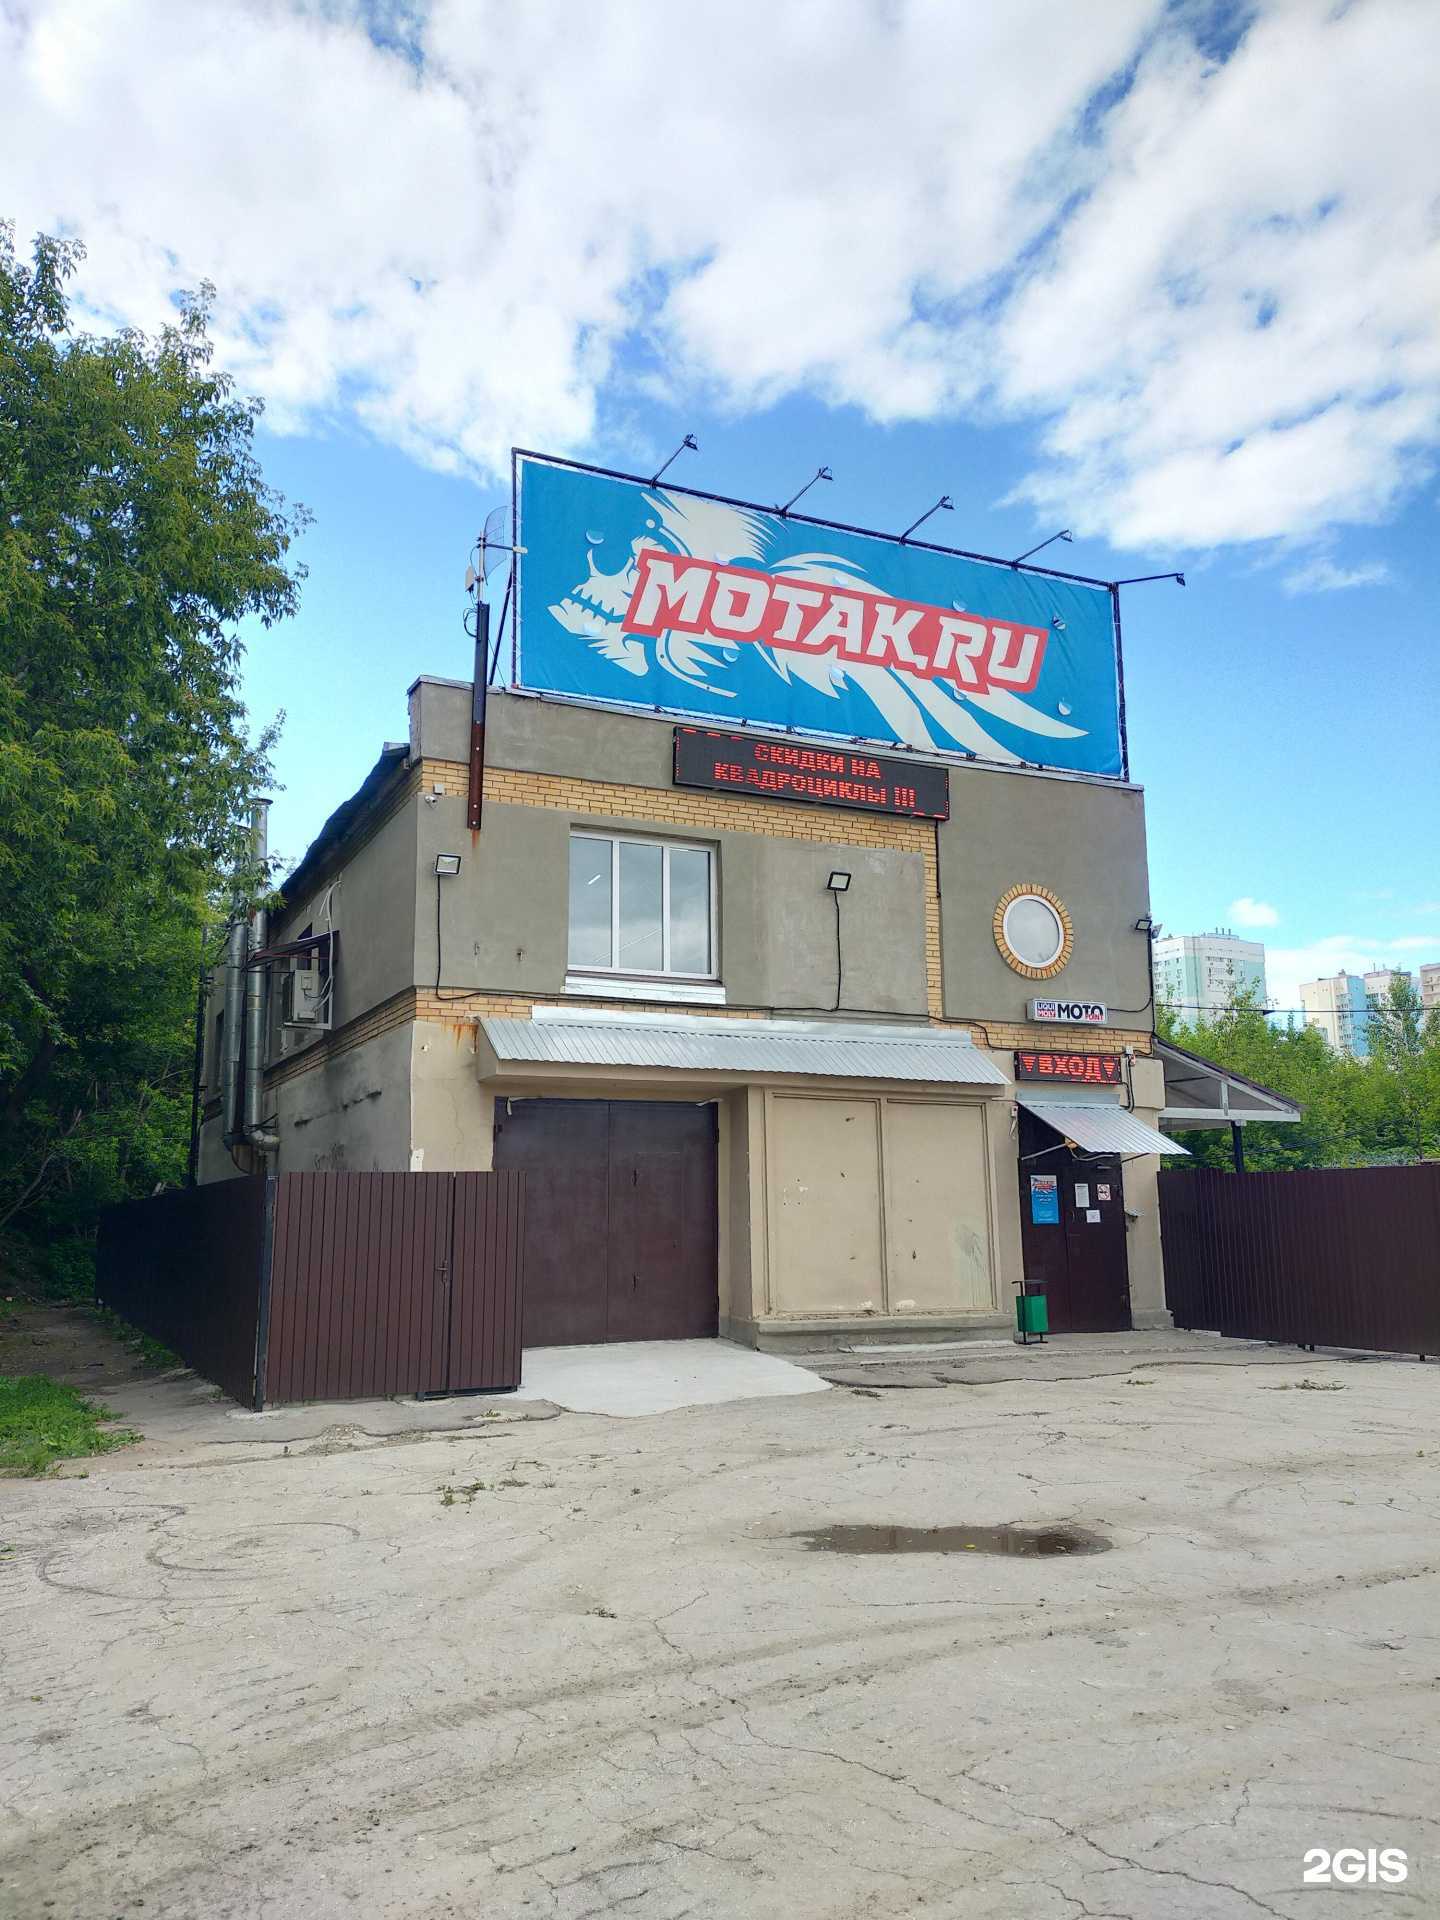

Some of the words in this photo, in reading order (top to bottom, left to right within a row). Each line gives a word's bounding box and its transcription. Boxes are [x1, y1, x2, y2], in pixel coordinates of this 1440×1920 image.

[754, 744, 844, 773] СКИДКИ
[850, 759, 881, 779] НА
[713, 762, 887, 804] КВАДРОЦИКЛЫ
[1037, 1002, 1055, 1010] LIQUI
[1037, 1009, 1055, 1018] MOLY
[1038, 1055, 1102, 1080] ВХОД
